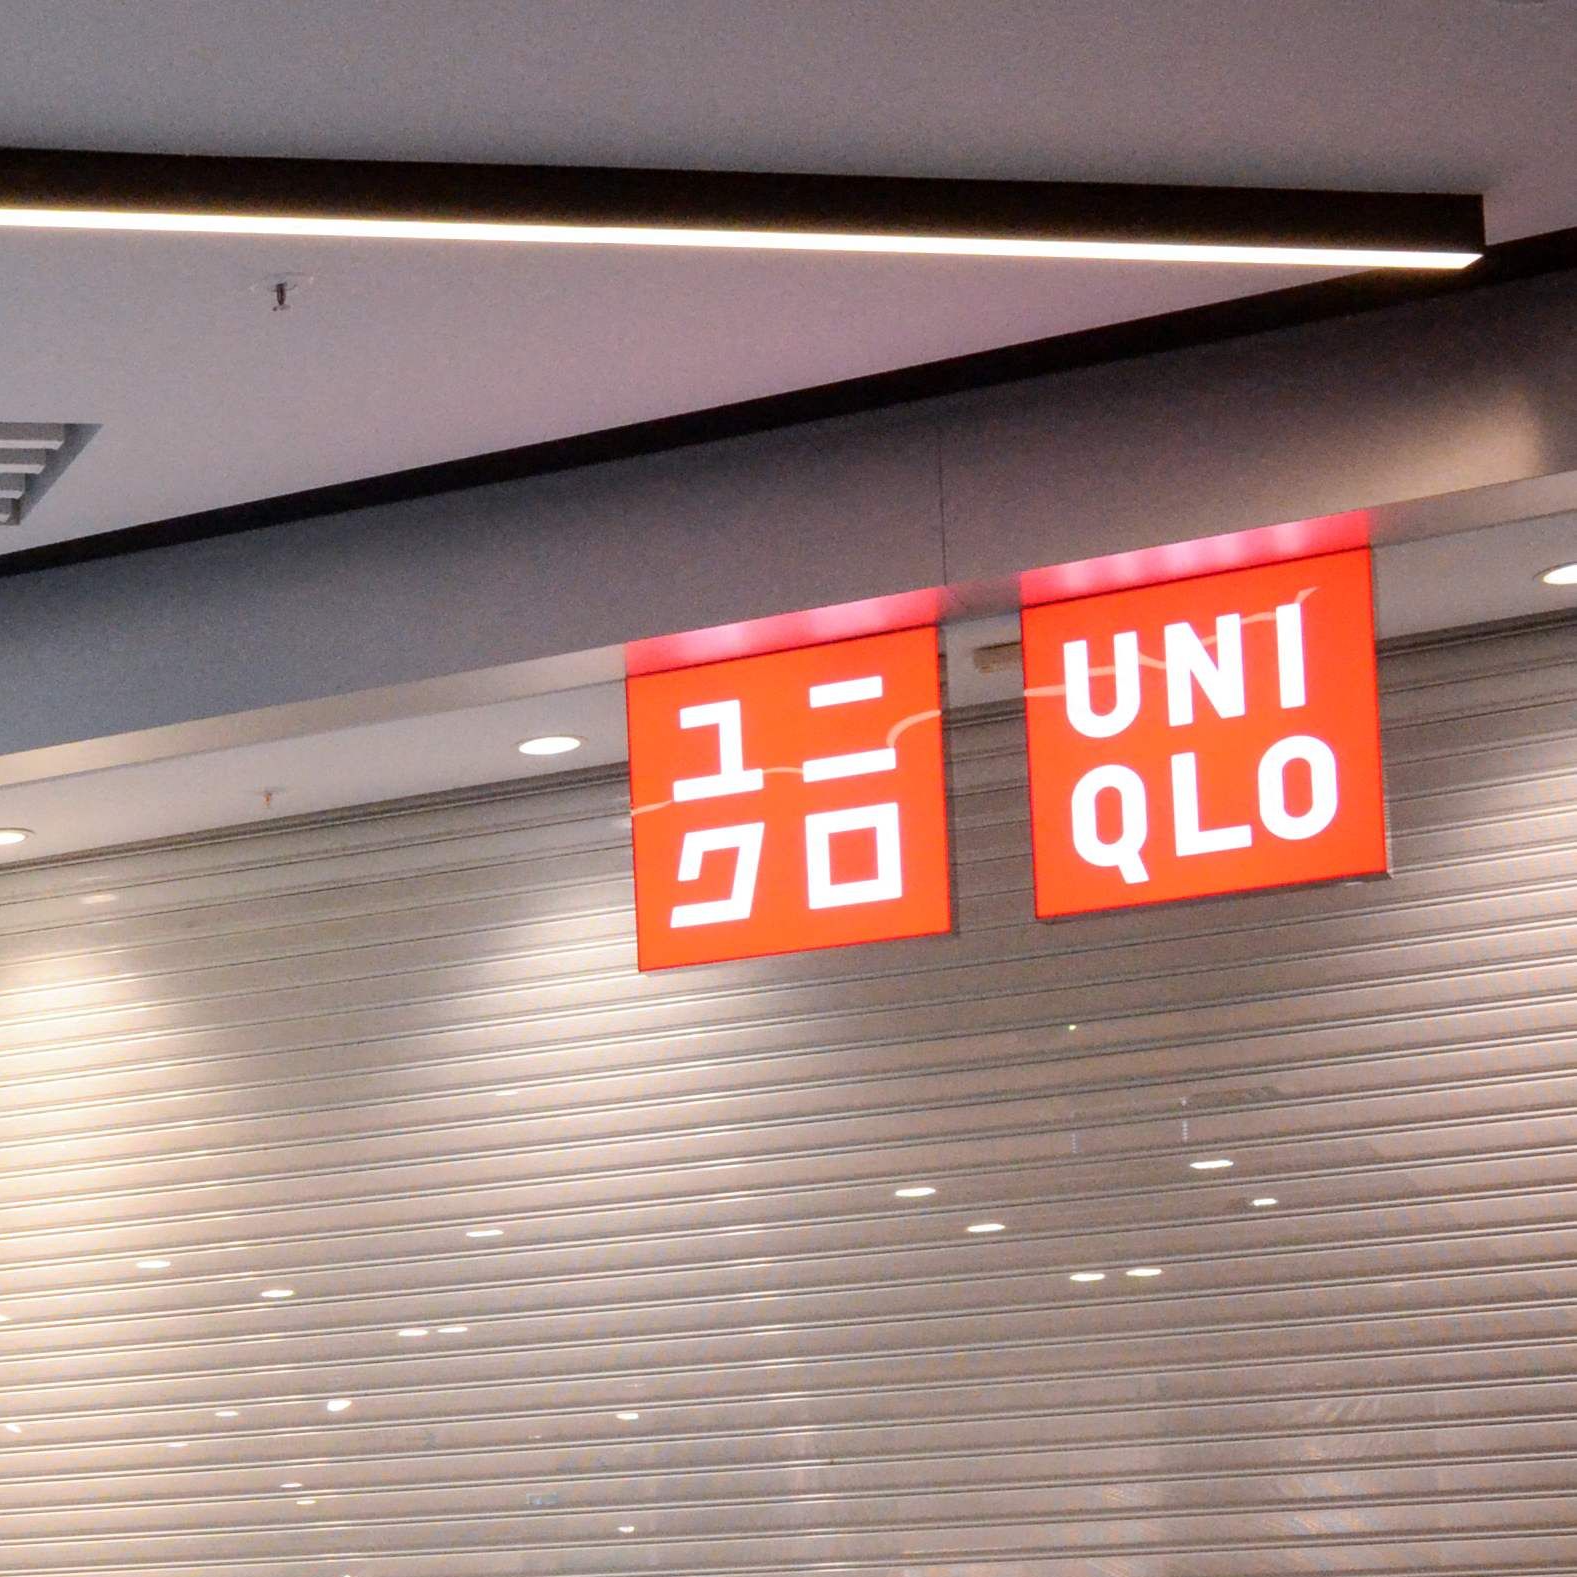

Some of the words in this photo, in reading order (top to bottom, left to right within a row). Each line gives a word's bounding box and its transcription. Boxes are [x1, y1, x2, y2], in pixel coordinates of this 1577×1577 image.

[1062, 602, 1306, 739] UNI
[672, 675, 897, 803] ユニ
[669, 801, 903, 930] クロ
[1070, 734, 1339, 884] QLO
